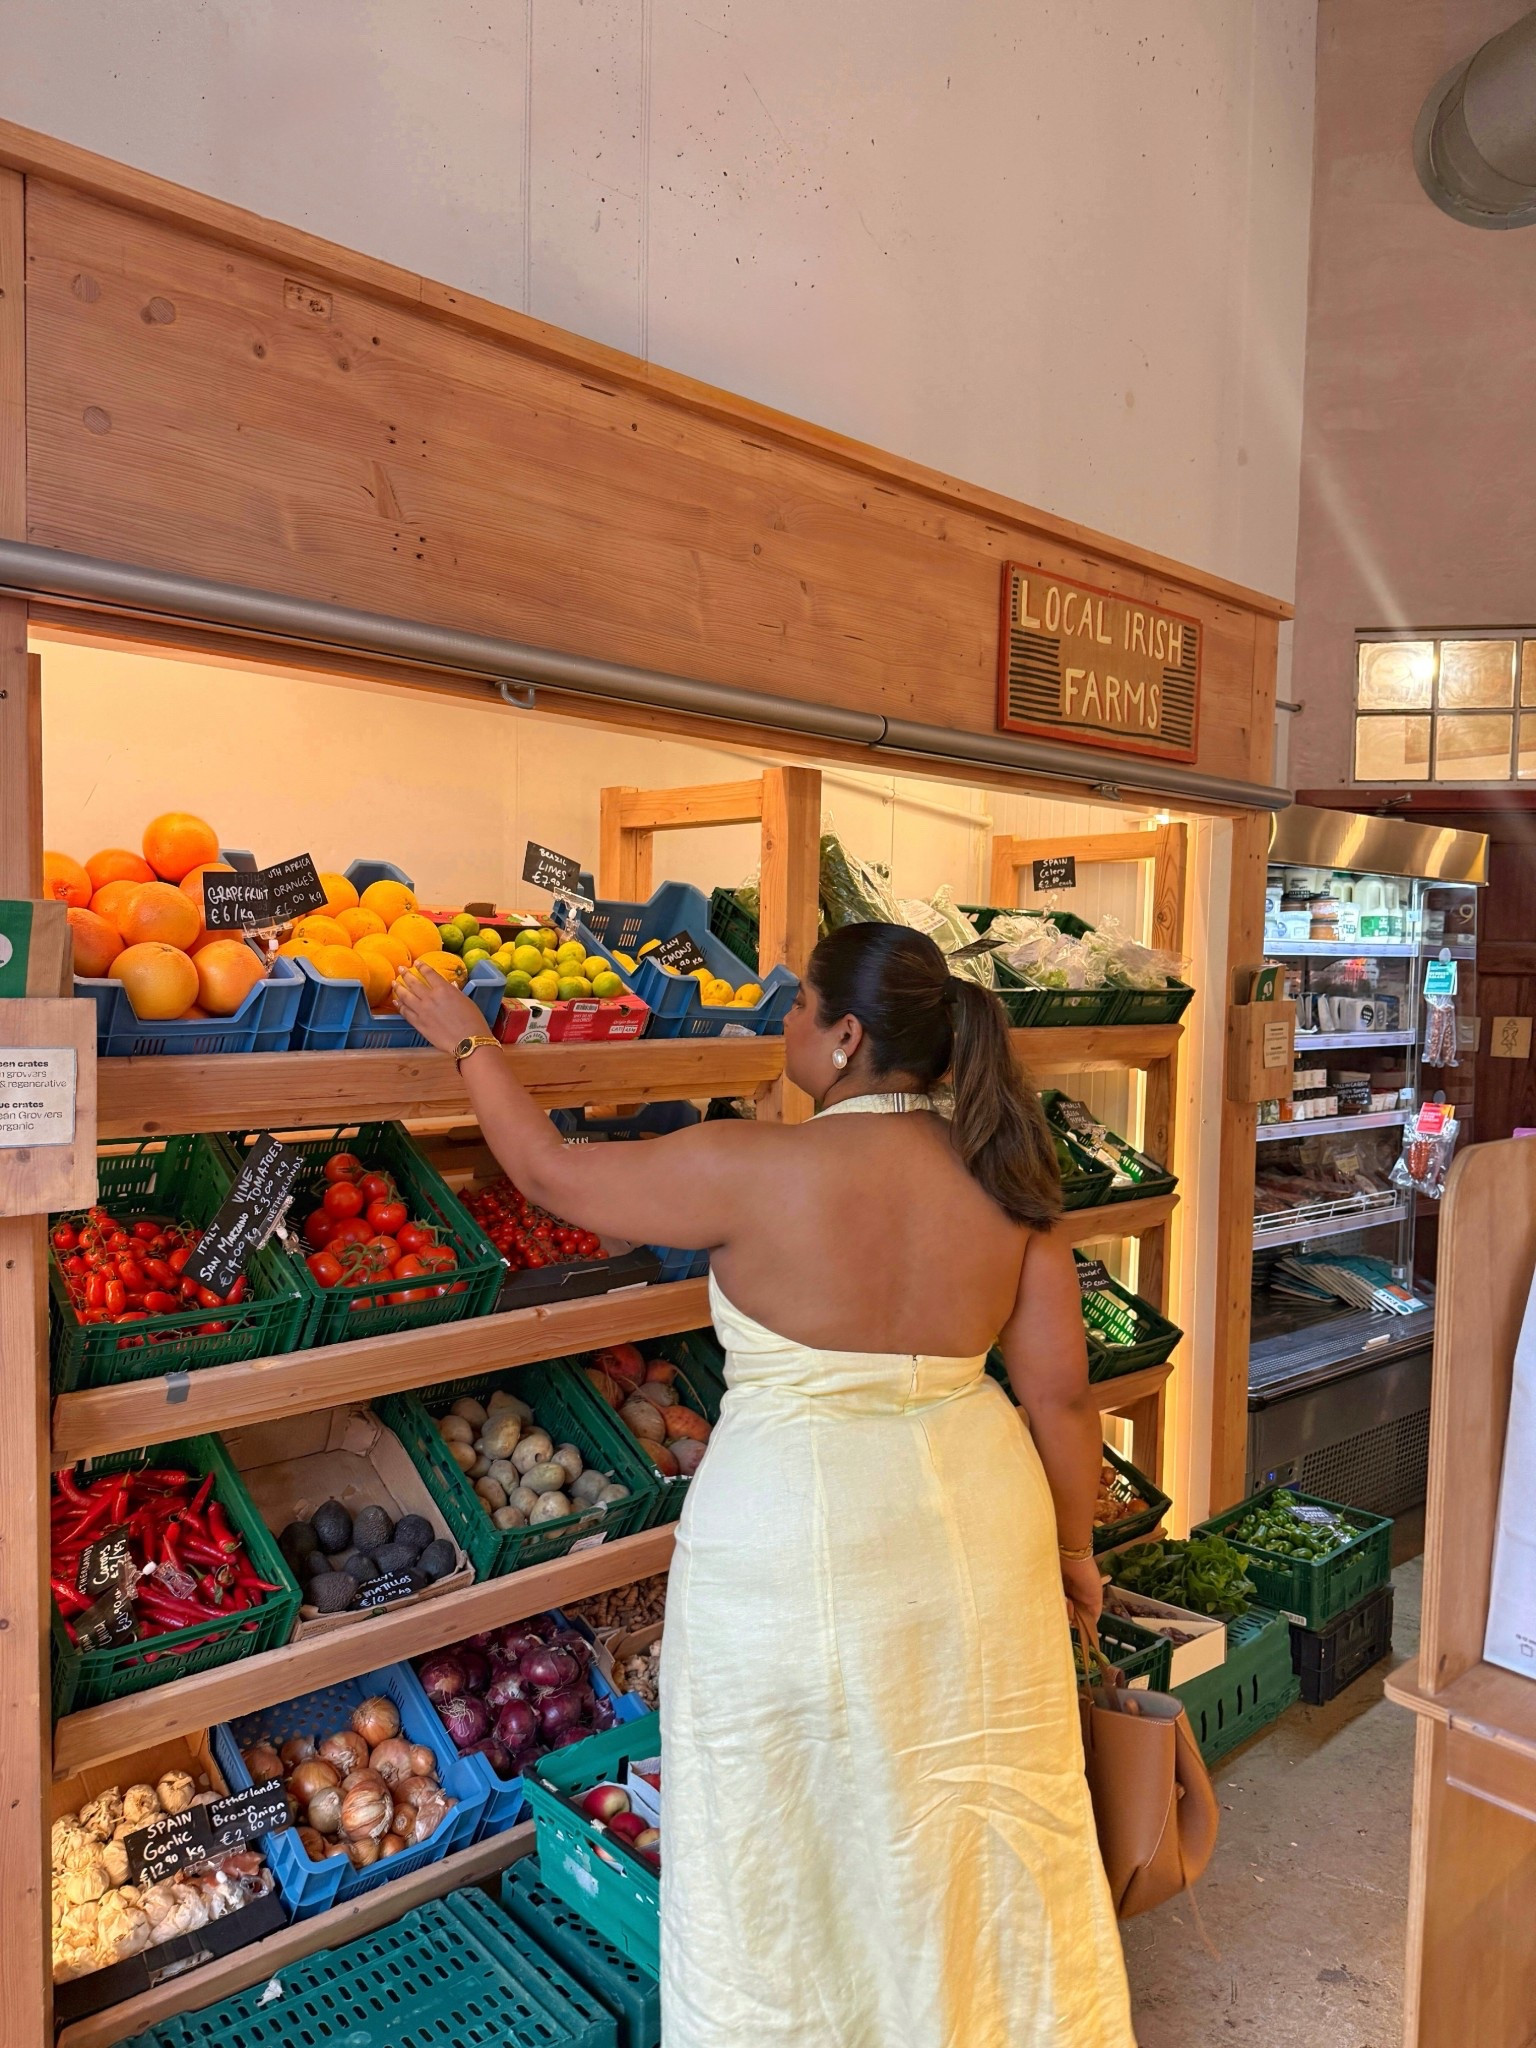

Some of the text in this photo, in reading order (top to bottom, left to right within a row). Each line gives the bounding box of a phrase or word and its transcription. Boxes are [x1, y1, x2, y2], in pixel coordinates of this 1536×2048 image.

[1021, 580, 1183, 667] LOCAL IRISH
[1065, 667, 1160, 730] FARMS
[268, 857, 311, 879] UTH AFRICA
[539, 848, 567, 866] BRAZIL
[1042, 858, 1068, 868] SPAIN
[532, 871, 560, 887] €7.90
[538, 860, 567, 880] LIMES
[1039, 868, 1066, 878] Celery
[273, 872, 315, 897] ORANGES
[659, 937, 680, 953] ITALY
[6, 1070, 47, 1079] growers
[17, 1060, 49, 1068] crates
[7, 1079, 67, 1089] regenerative
[18, 1111, 63, 1119] Growers
[245, 1141, 283, 1202] TOMATOES
[231, 1166, 253, 1204] VINE
[266, 1156, 304, 1223] NETHERLANDS
[254, 1180, 274, 1216] €3.00
[197, 1223, 220, 1256] ITALY
[199, 1212, 249, 1282] SAN MARZANO
[354, 1575, 412, 1599] OMATILLOS
[79, 1634, 95, 1651] PAIN
[211, 1779, 281, 1813] netherlands
[212, 1805, 256, 1828] Brown
[247, 1801, 286, 1824] Onion
[147, 1812, 193, 1839] SPAIN
[219, 1821, 265, 1846] €2.60
[143, 1830, 193, 1861] Garlic
